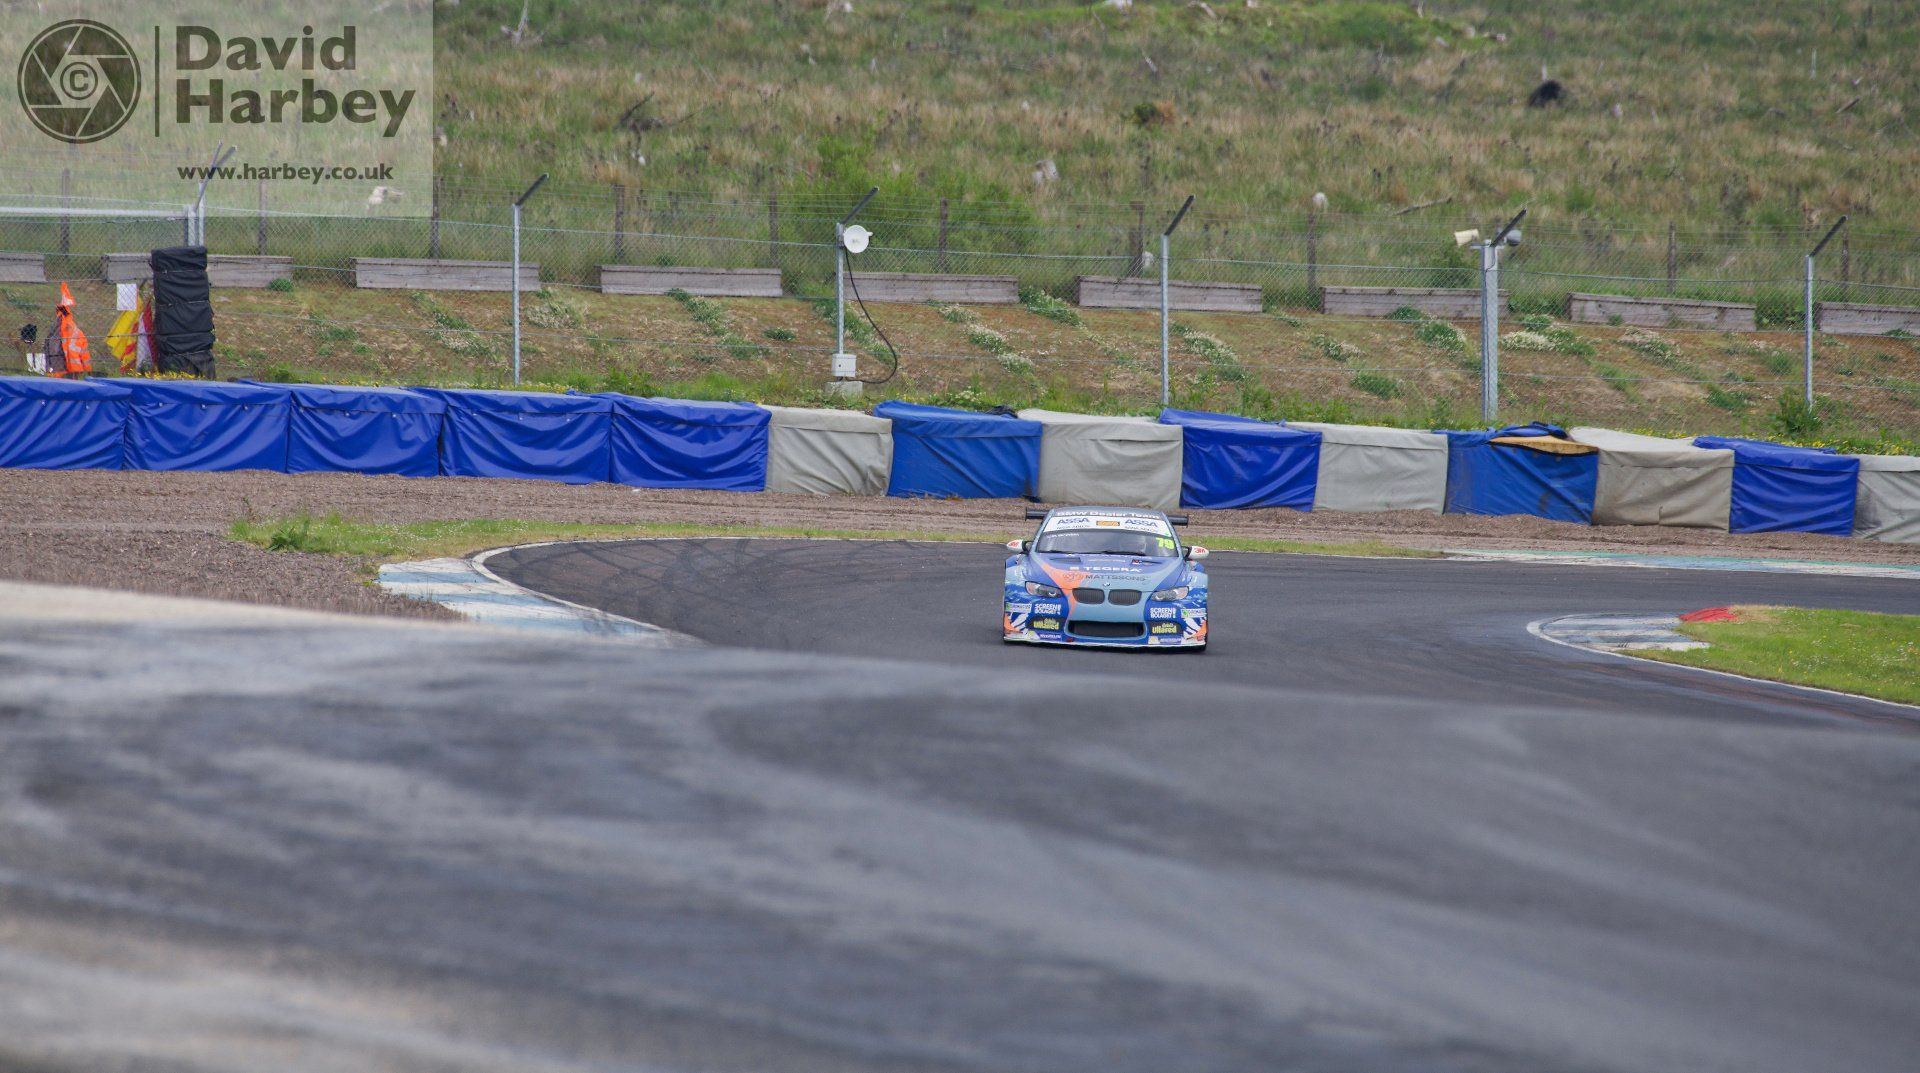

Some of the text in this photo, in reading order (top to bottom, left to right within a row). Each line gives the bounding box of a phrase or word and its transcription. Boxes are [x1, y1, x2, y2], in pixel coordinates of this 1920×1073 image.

[1129, 512, 1160, 520] Team
[1057, 517, 1089, 525] ASSA
[1125, 519, 1158, 528] ASSA
[1155, 537, 1175, 550] 79
